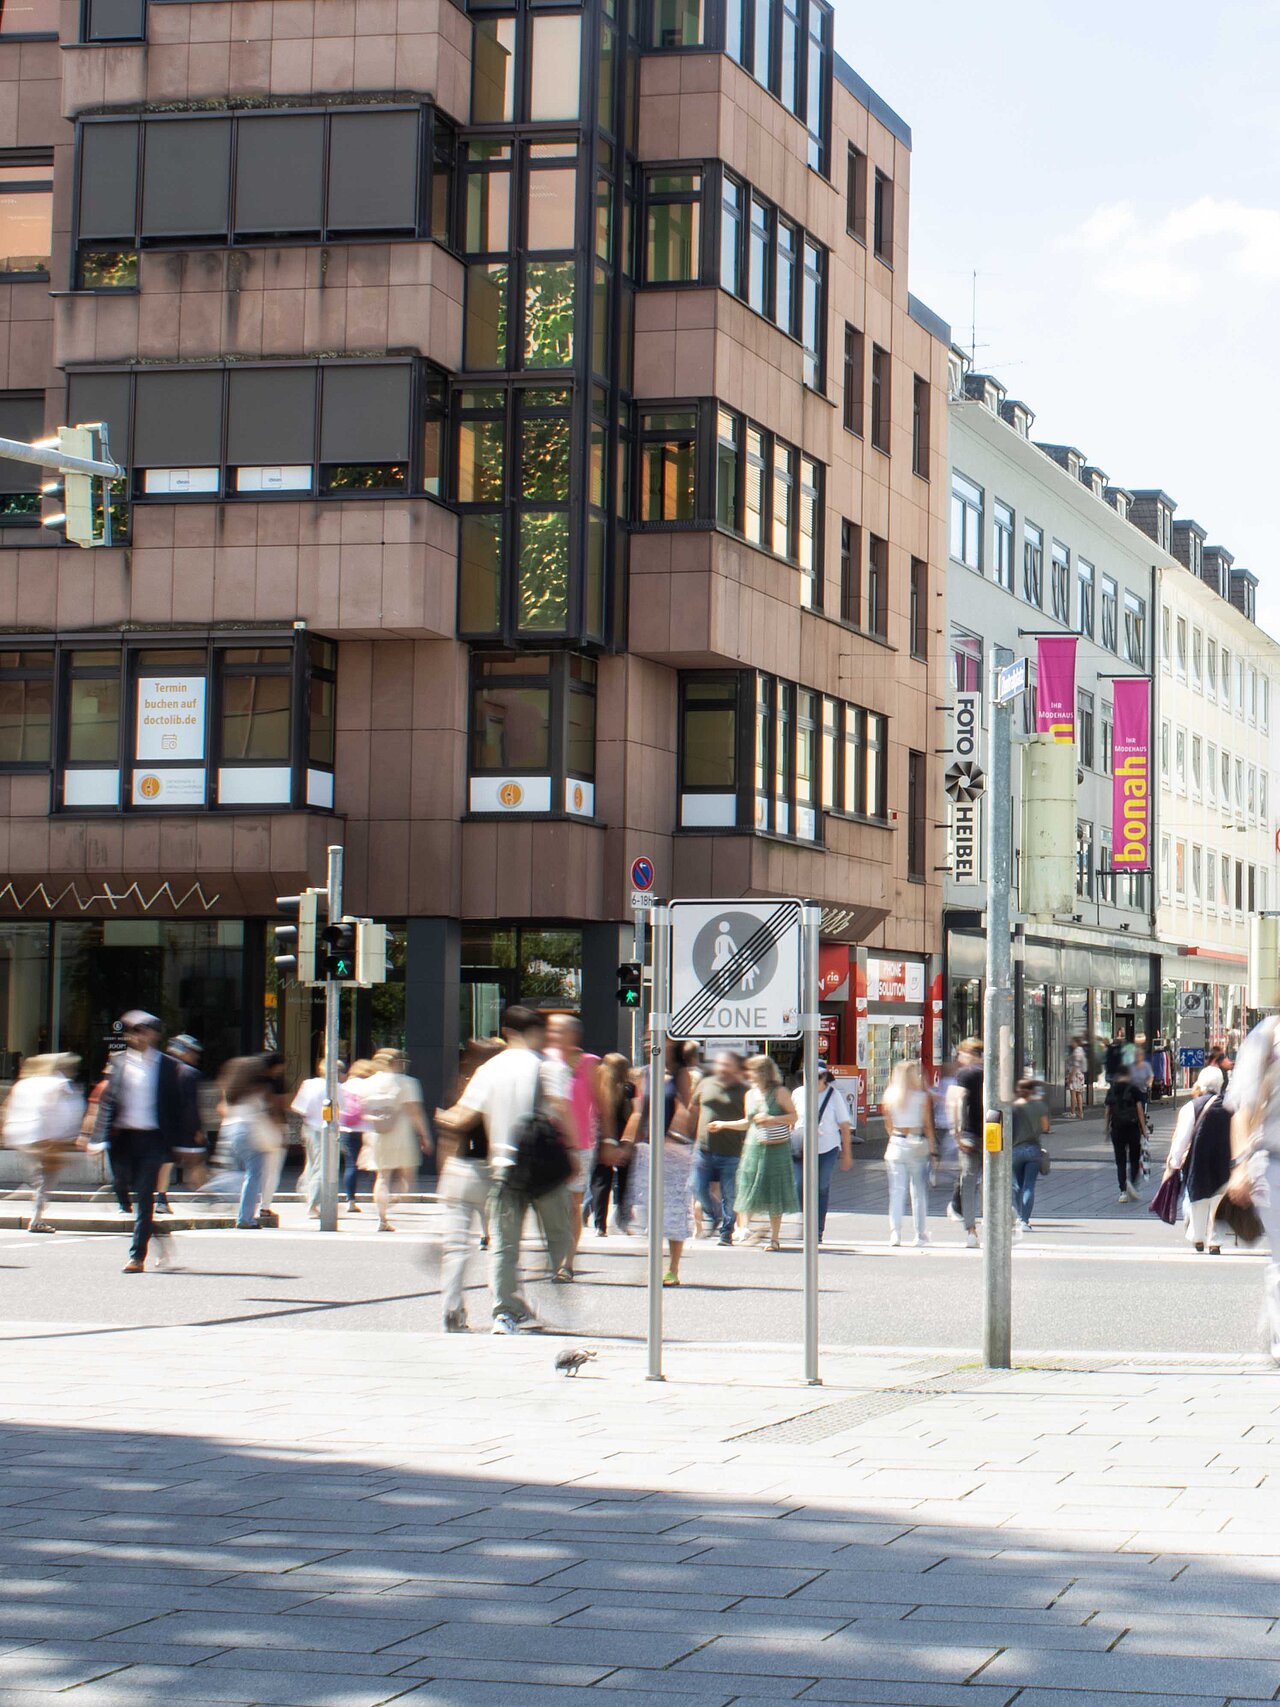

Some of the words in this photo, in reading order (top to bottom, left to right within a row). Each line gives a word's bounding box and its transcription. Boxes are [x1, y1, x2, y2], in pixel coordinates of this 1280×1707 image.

[154, 682, 188, 693] Termin
[144, 698, 179, 709] buchen
[180, 698, 197, 709] auf
[143, 714, 197, 725] doctolib.de
[956, 698, 975, 756] FOTO
[1114, 756, 1147, 862] bonah
[955, 807, 973, 883] HEIBEL
[826, 971, 840, 982] ria
[702, 1007, 768, 1028] ZONE
